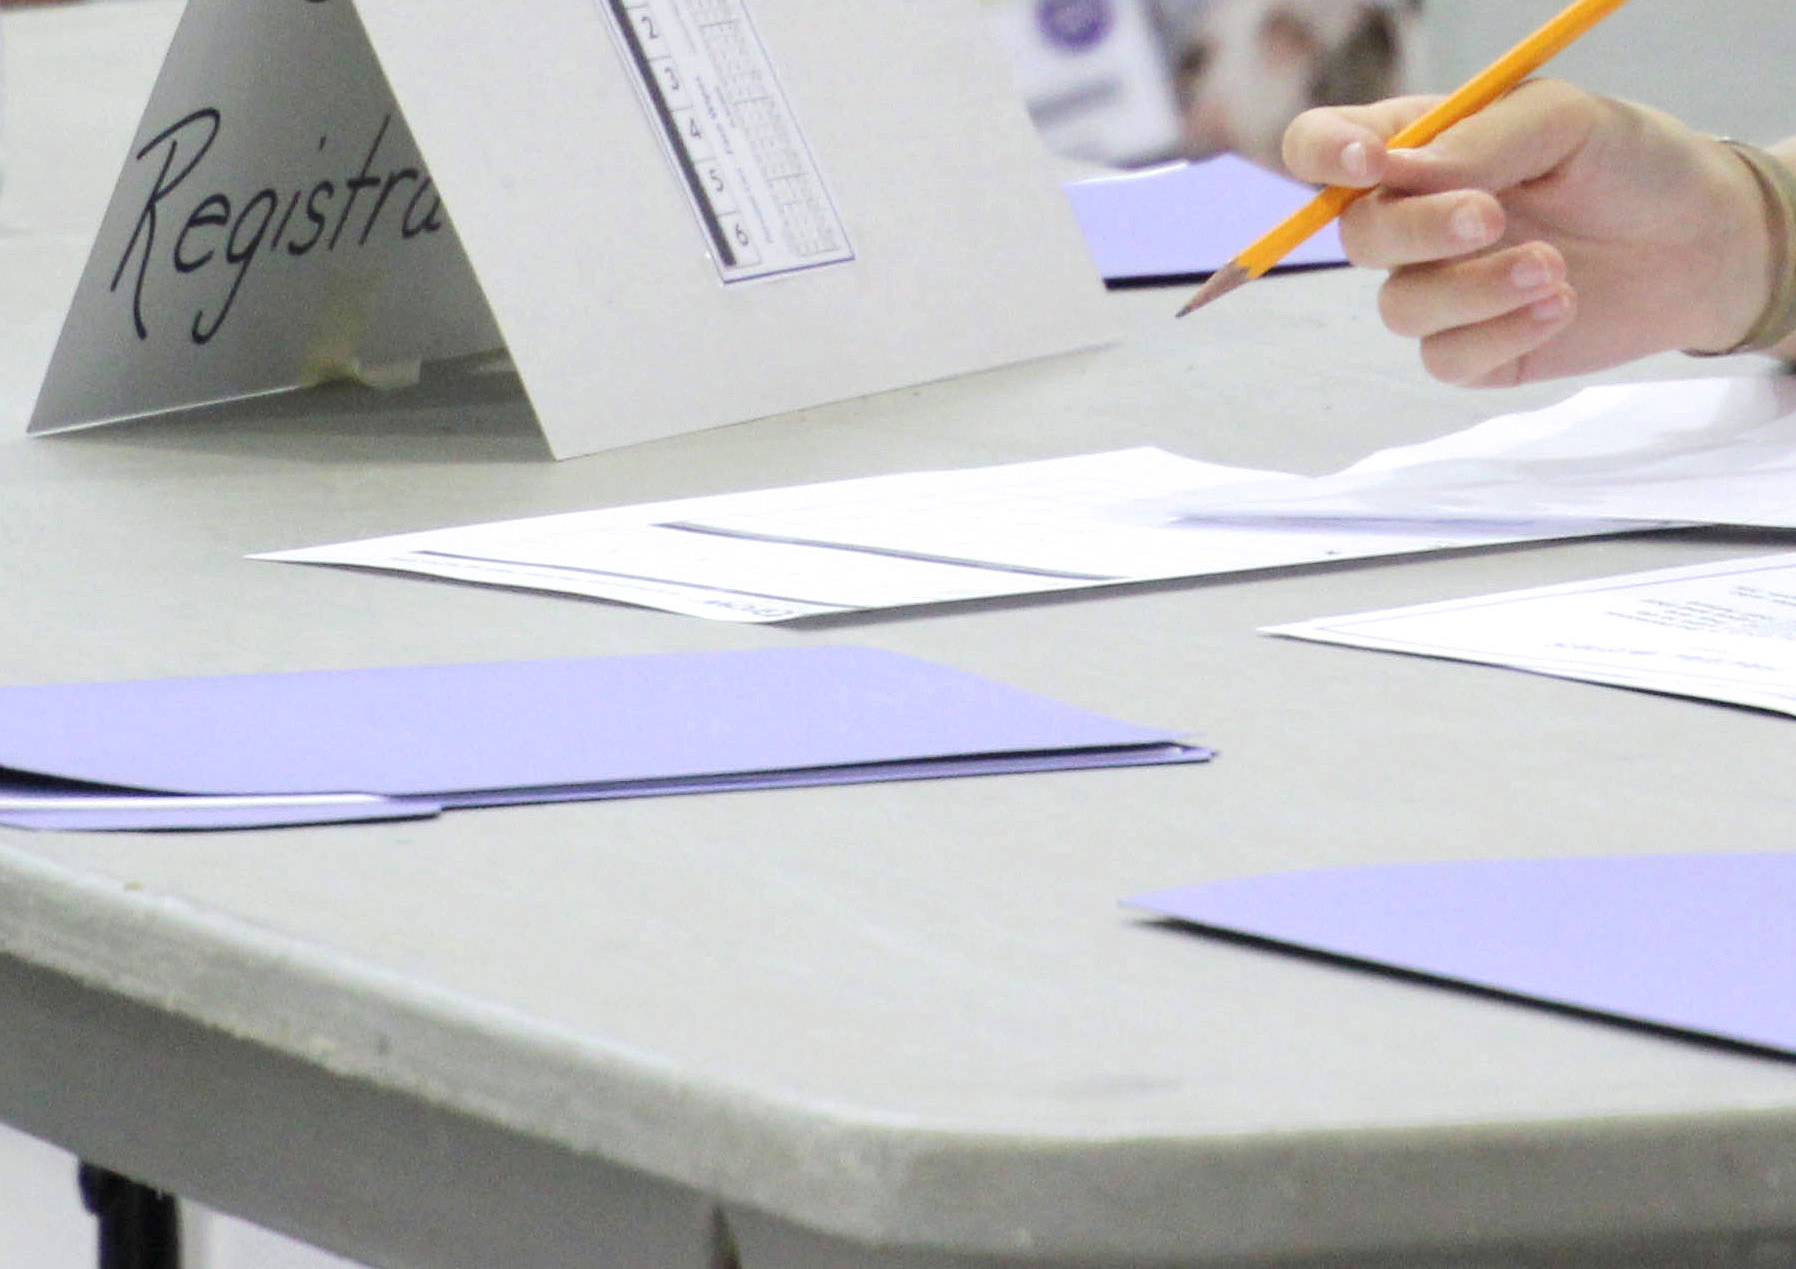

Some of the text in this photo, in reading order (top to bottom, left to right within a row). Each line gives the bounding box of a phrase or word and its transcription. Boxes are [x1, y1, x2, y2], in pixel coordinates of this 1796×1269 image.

[641, 15, 659, 40] 2
[664, 66, 680, 91] 3
[689, 117, 703, 139] 4
[709, 168, 724, 192] 5
[735, 222, 749, 247] 6
